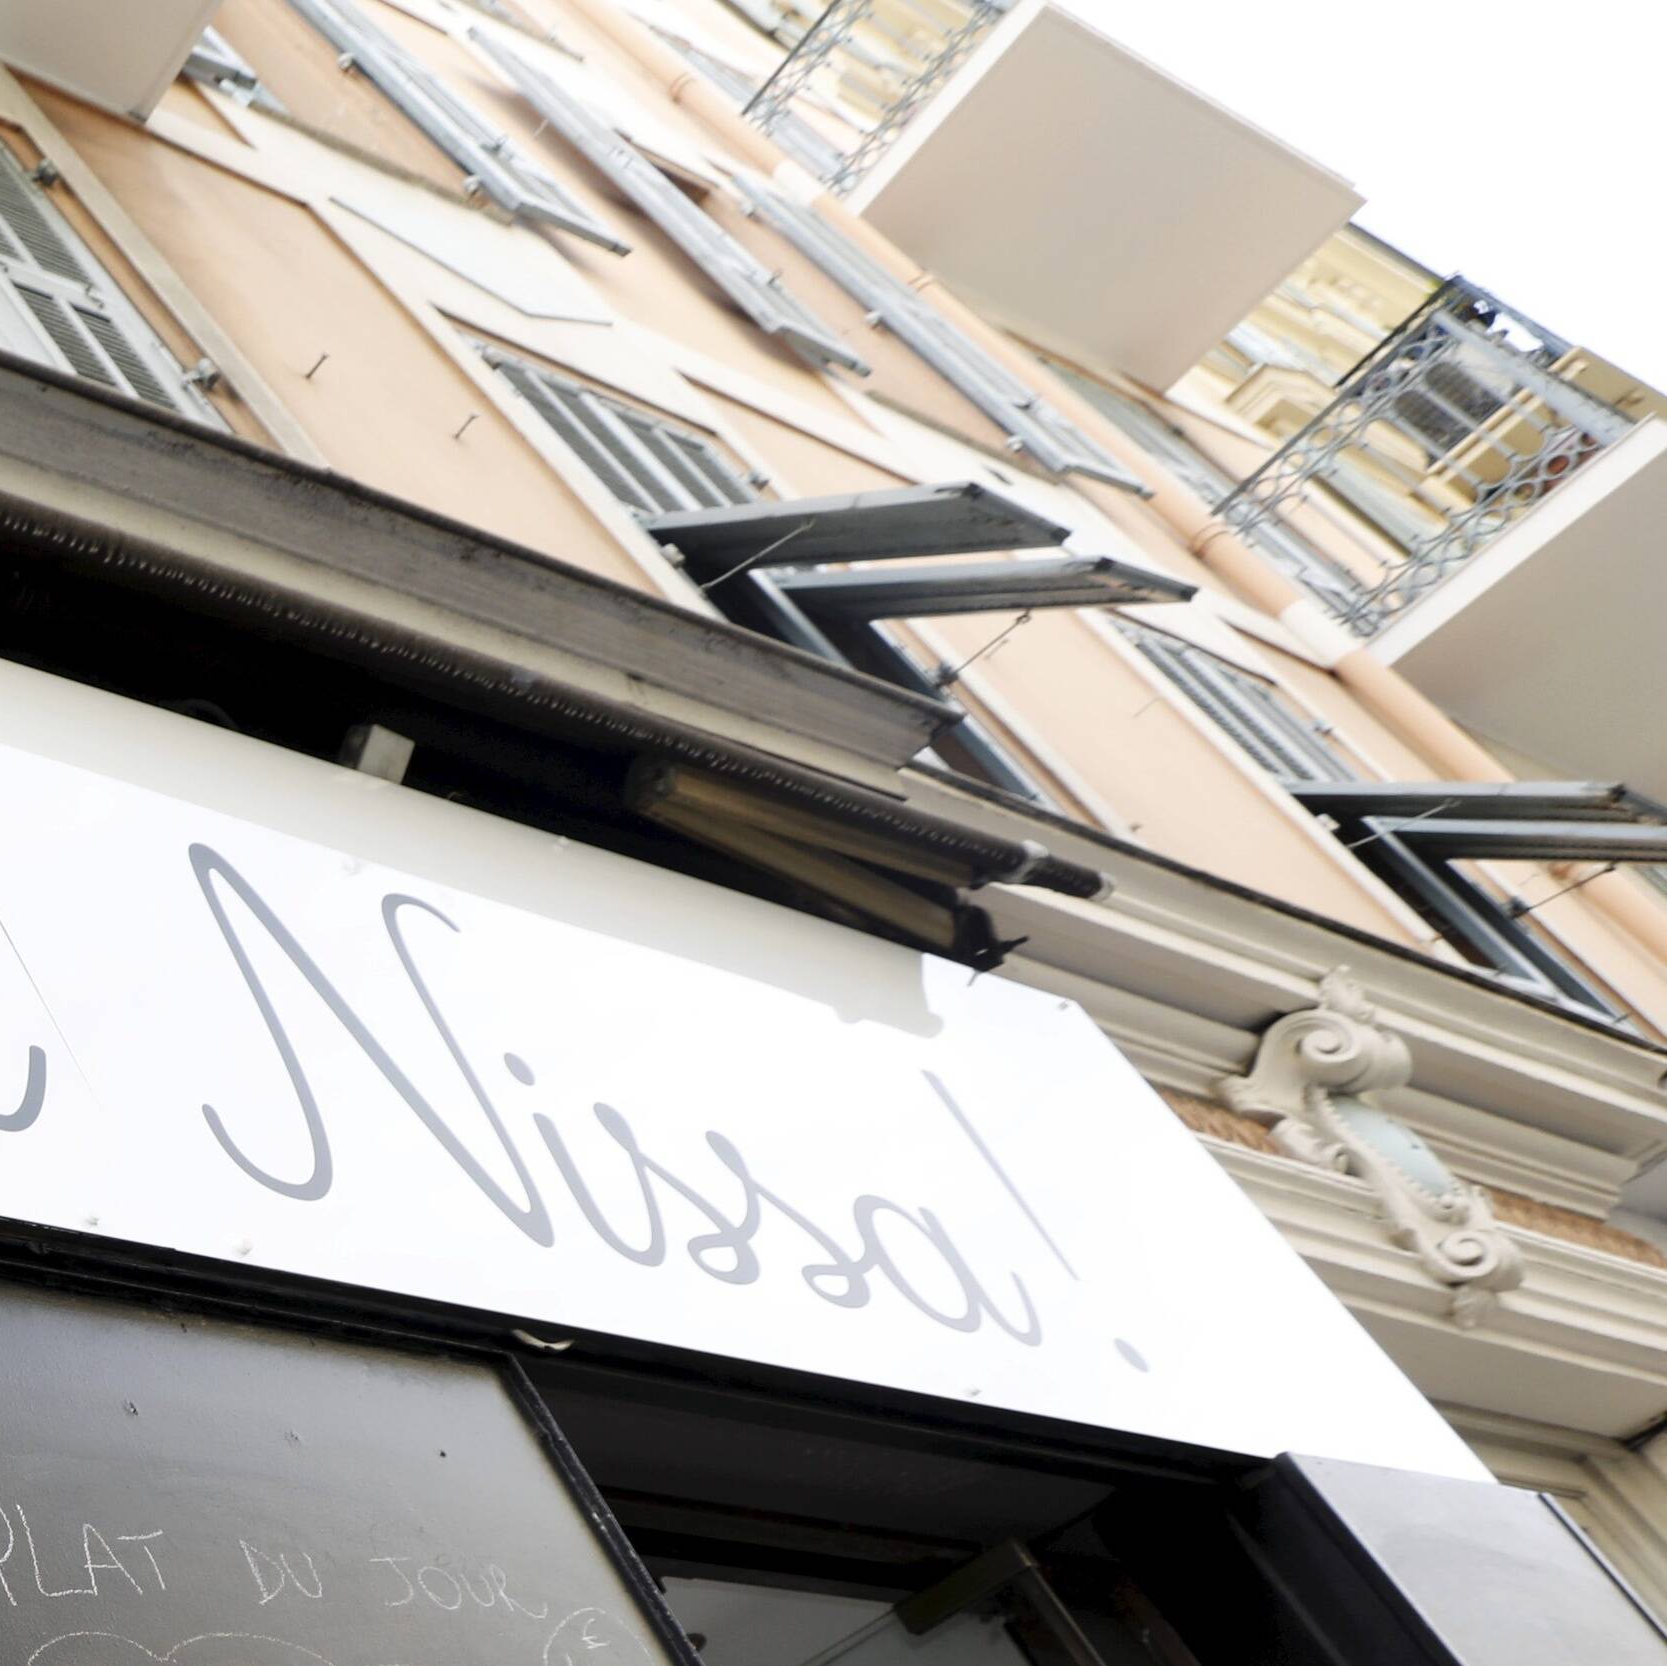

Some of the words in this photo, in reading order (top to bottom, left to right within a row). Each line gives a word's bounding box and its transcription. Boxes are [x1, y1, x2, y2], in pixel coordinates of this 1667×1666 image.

[188, 840, 1151, 1373] Nissa!
[238, 1538, 323, 1605] DU
[369, 1555, 549, 1619] JOUR
